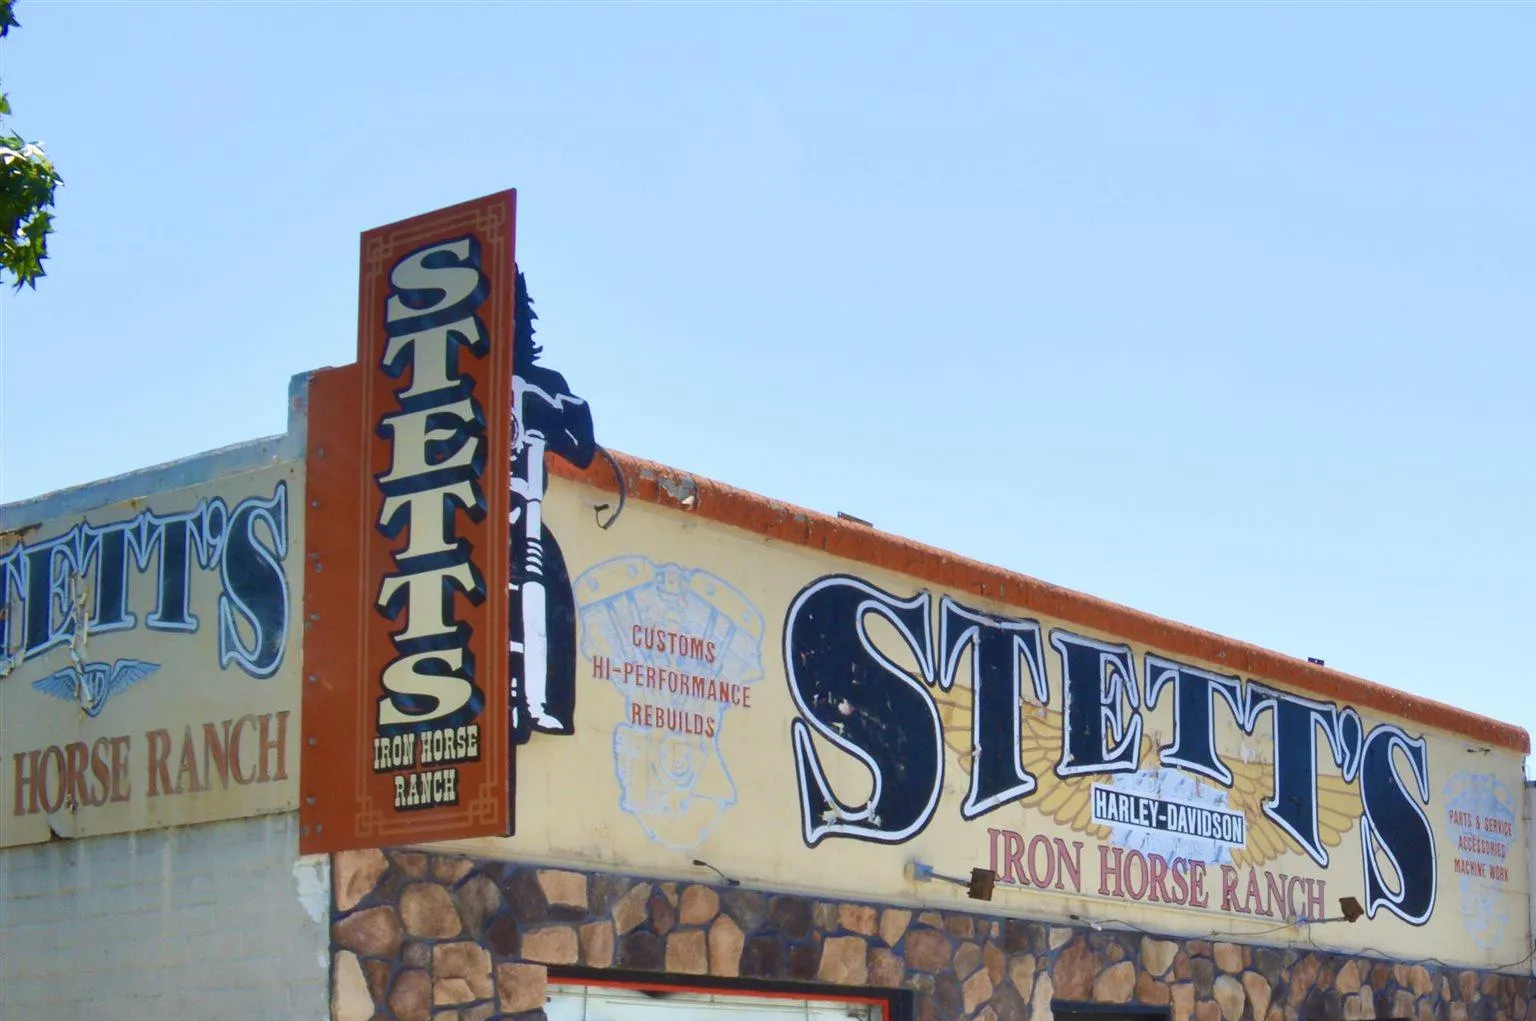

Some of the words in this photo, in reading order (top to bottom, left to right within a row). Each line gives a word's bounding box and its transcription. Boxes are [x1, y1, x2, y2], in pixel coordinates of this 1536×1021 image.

[379, 236, 486, 732] STETS
[631, 623, 716, 664] CUSTOMS
[592, 655, 751, 708] HI-PERFORMANCE
[631, 702, 715, 738] REBUILDS
[13, 735, 131, 816] HORSE
[146, 711, 290, 797] RANCH
[374, 733, 415, 769] IRON
[421, 725, 478, 763] HORSE
[782, 573, 1437, 925] STETT'S
[394, 769, 456, 807] RANCH
[1095, 789, 1242, 842] HARLEY-DAVIDSON
[1449, 809, 1472, 828] PARTS
[1475, 815, 1481, 830] &
[1484, 817, 1512, 837] SERVICE
[1458, 835, 1506, 858] ACCESSORIES
[987, 827, 1084, 895] IRON
[1100, 847, 1209, 910] HORSE
[1220, 863, 1325, 923] RANCH
[1454, 858, 1486, 878] MACHINE
[1489, 863, 1509, 882] WORK
